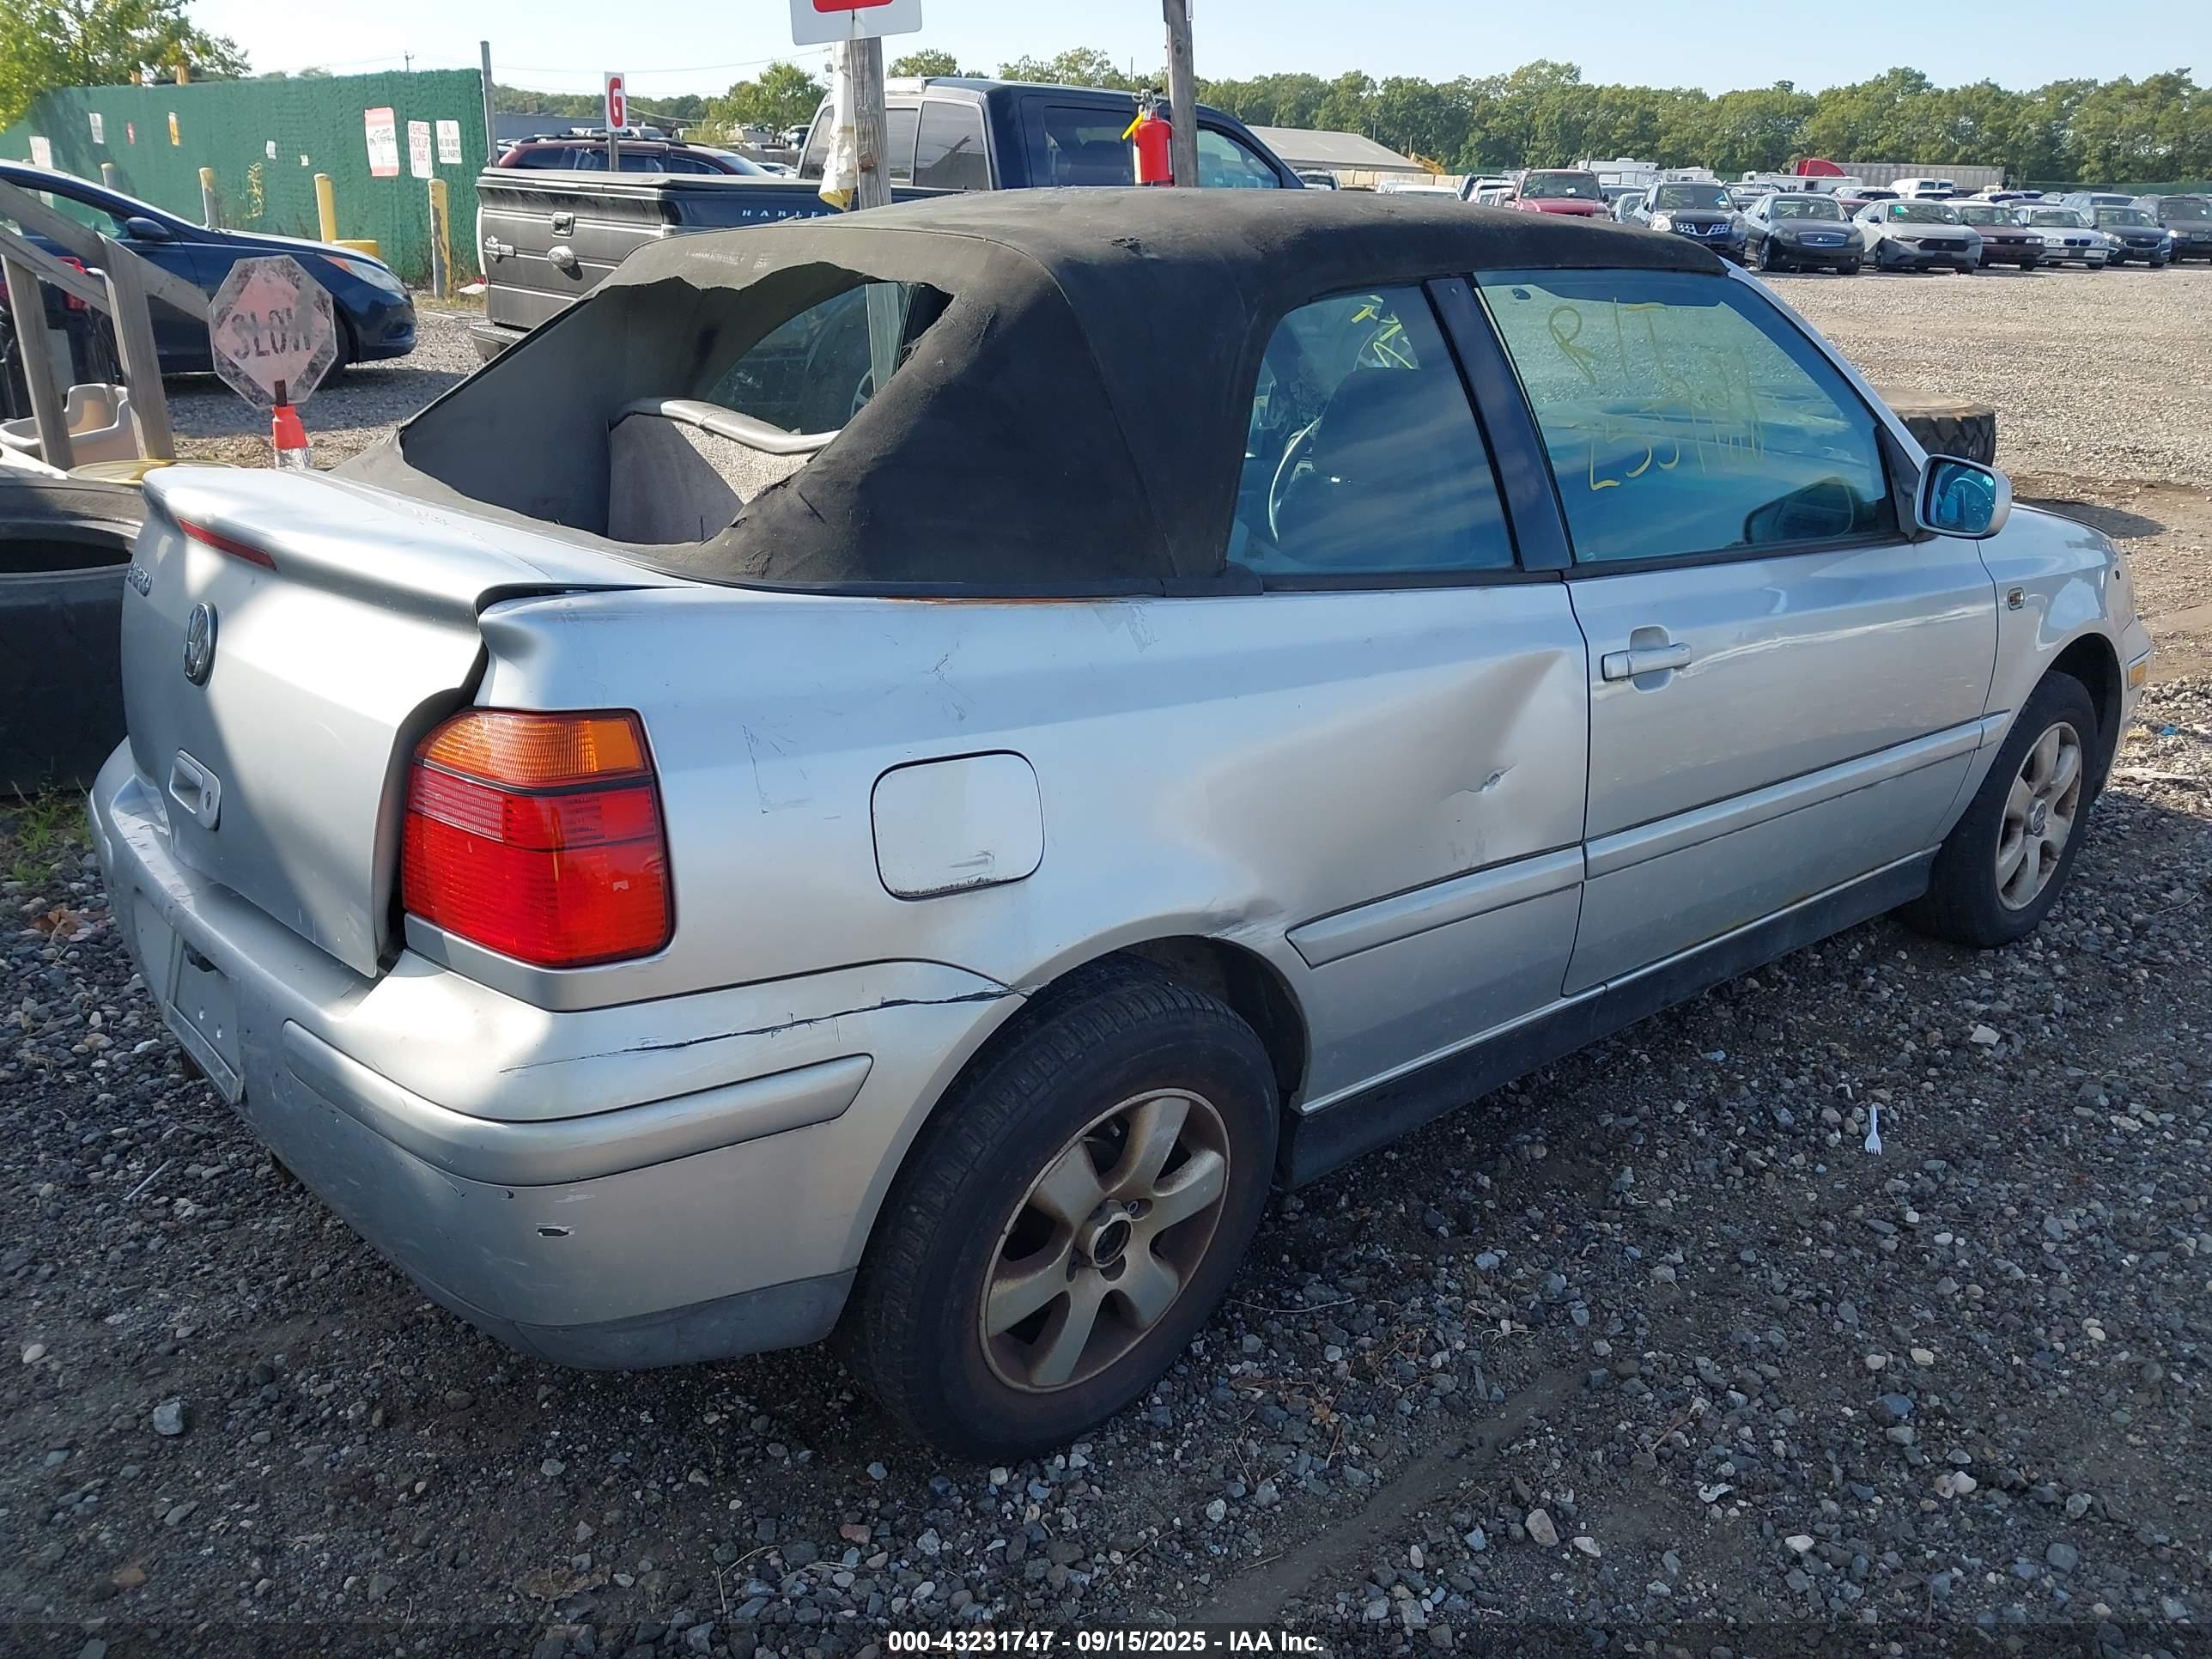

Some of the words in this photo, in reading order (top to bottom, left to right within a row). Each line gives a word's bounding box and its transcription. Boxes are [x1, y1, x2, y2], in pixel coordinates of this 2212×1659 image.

[609, 77, 623, 128] G
[410, 123, 430, 136] VEHICLE
[410, 136, 421, 148] PICK
[422, 137, 428, 149] UP
[416, 150, 427, 161] LINE
[447, 149, 461, 158] PARTS
